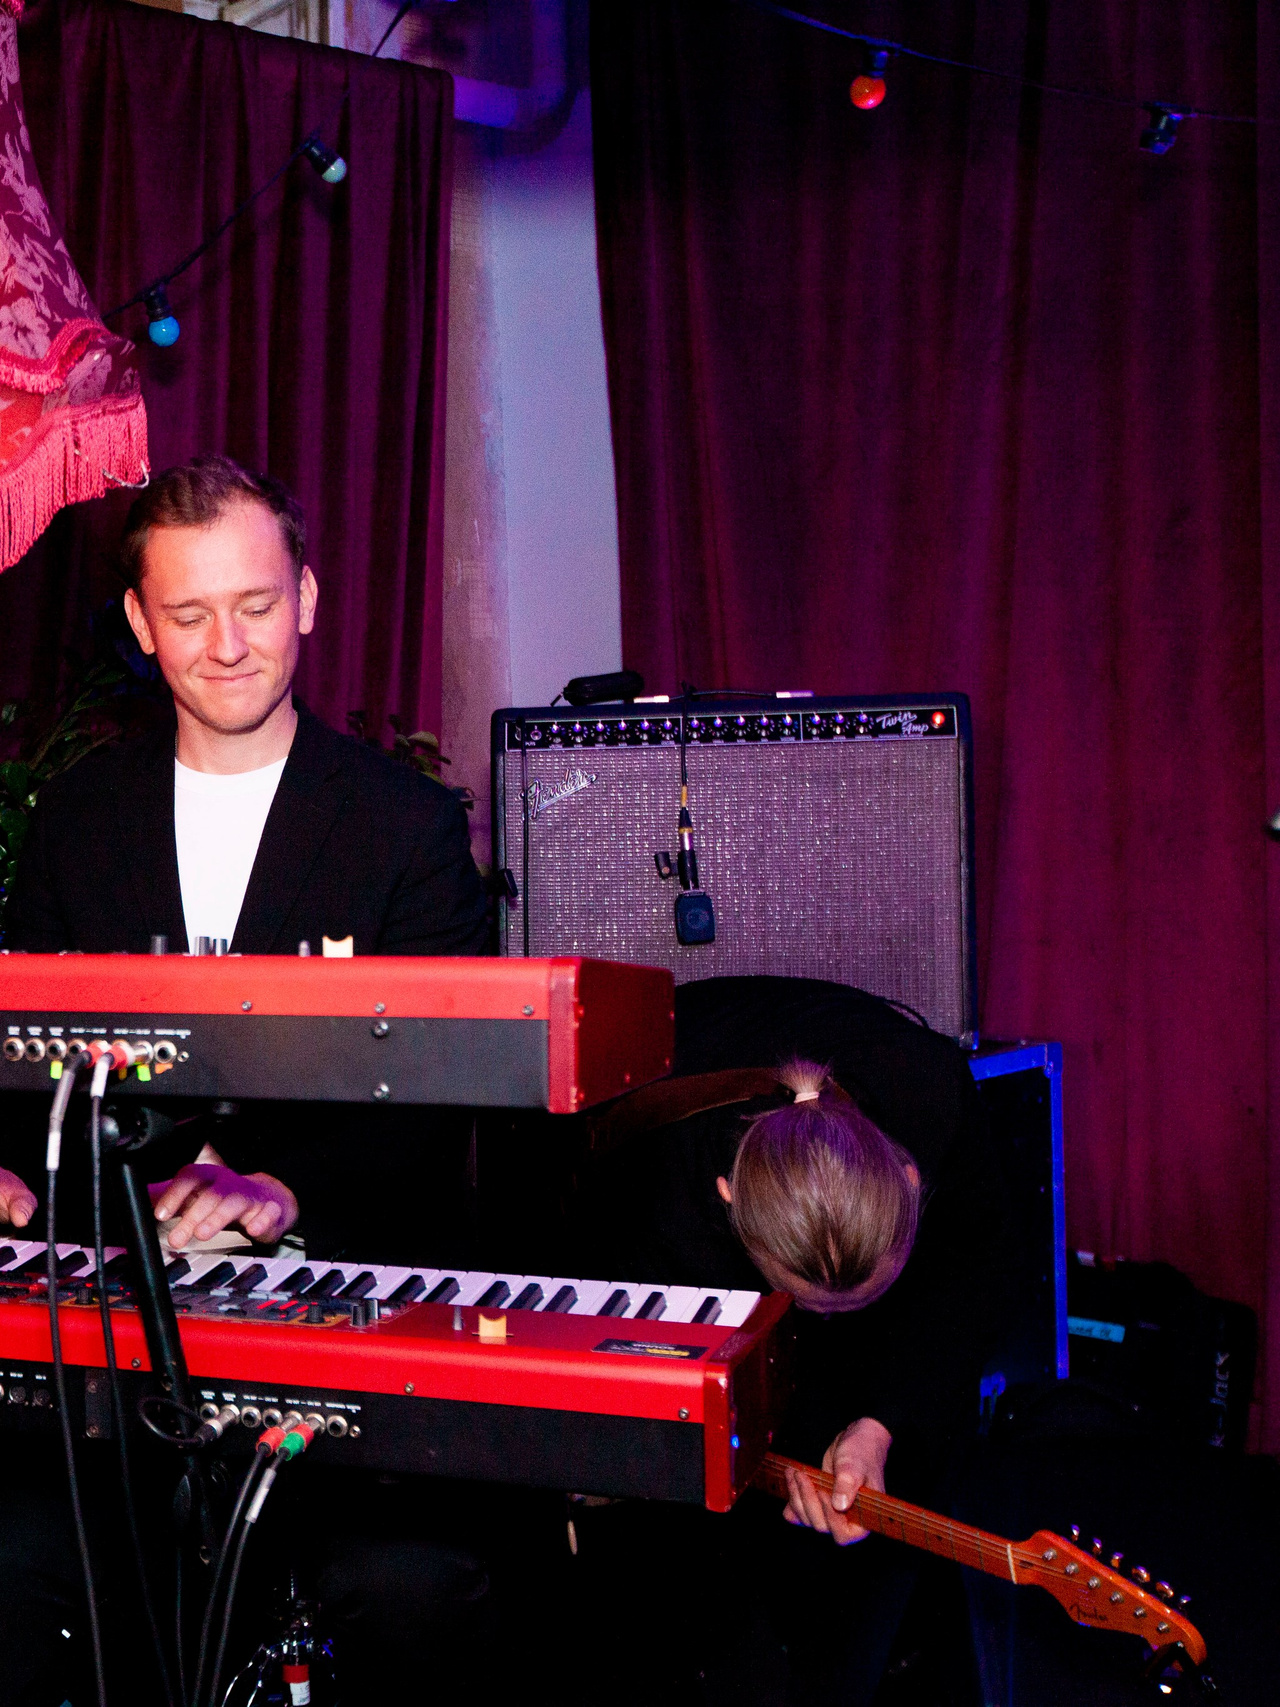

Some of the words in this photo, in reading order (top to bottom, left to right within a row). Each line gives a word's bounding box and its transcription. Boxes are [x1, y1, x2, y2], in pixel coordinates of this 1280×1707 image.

[876, 711, 917, 729] Twin
[902, 721, 929, 735] Amp
[519, 768, 598, 818] Fender
